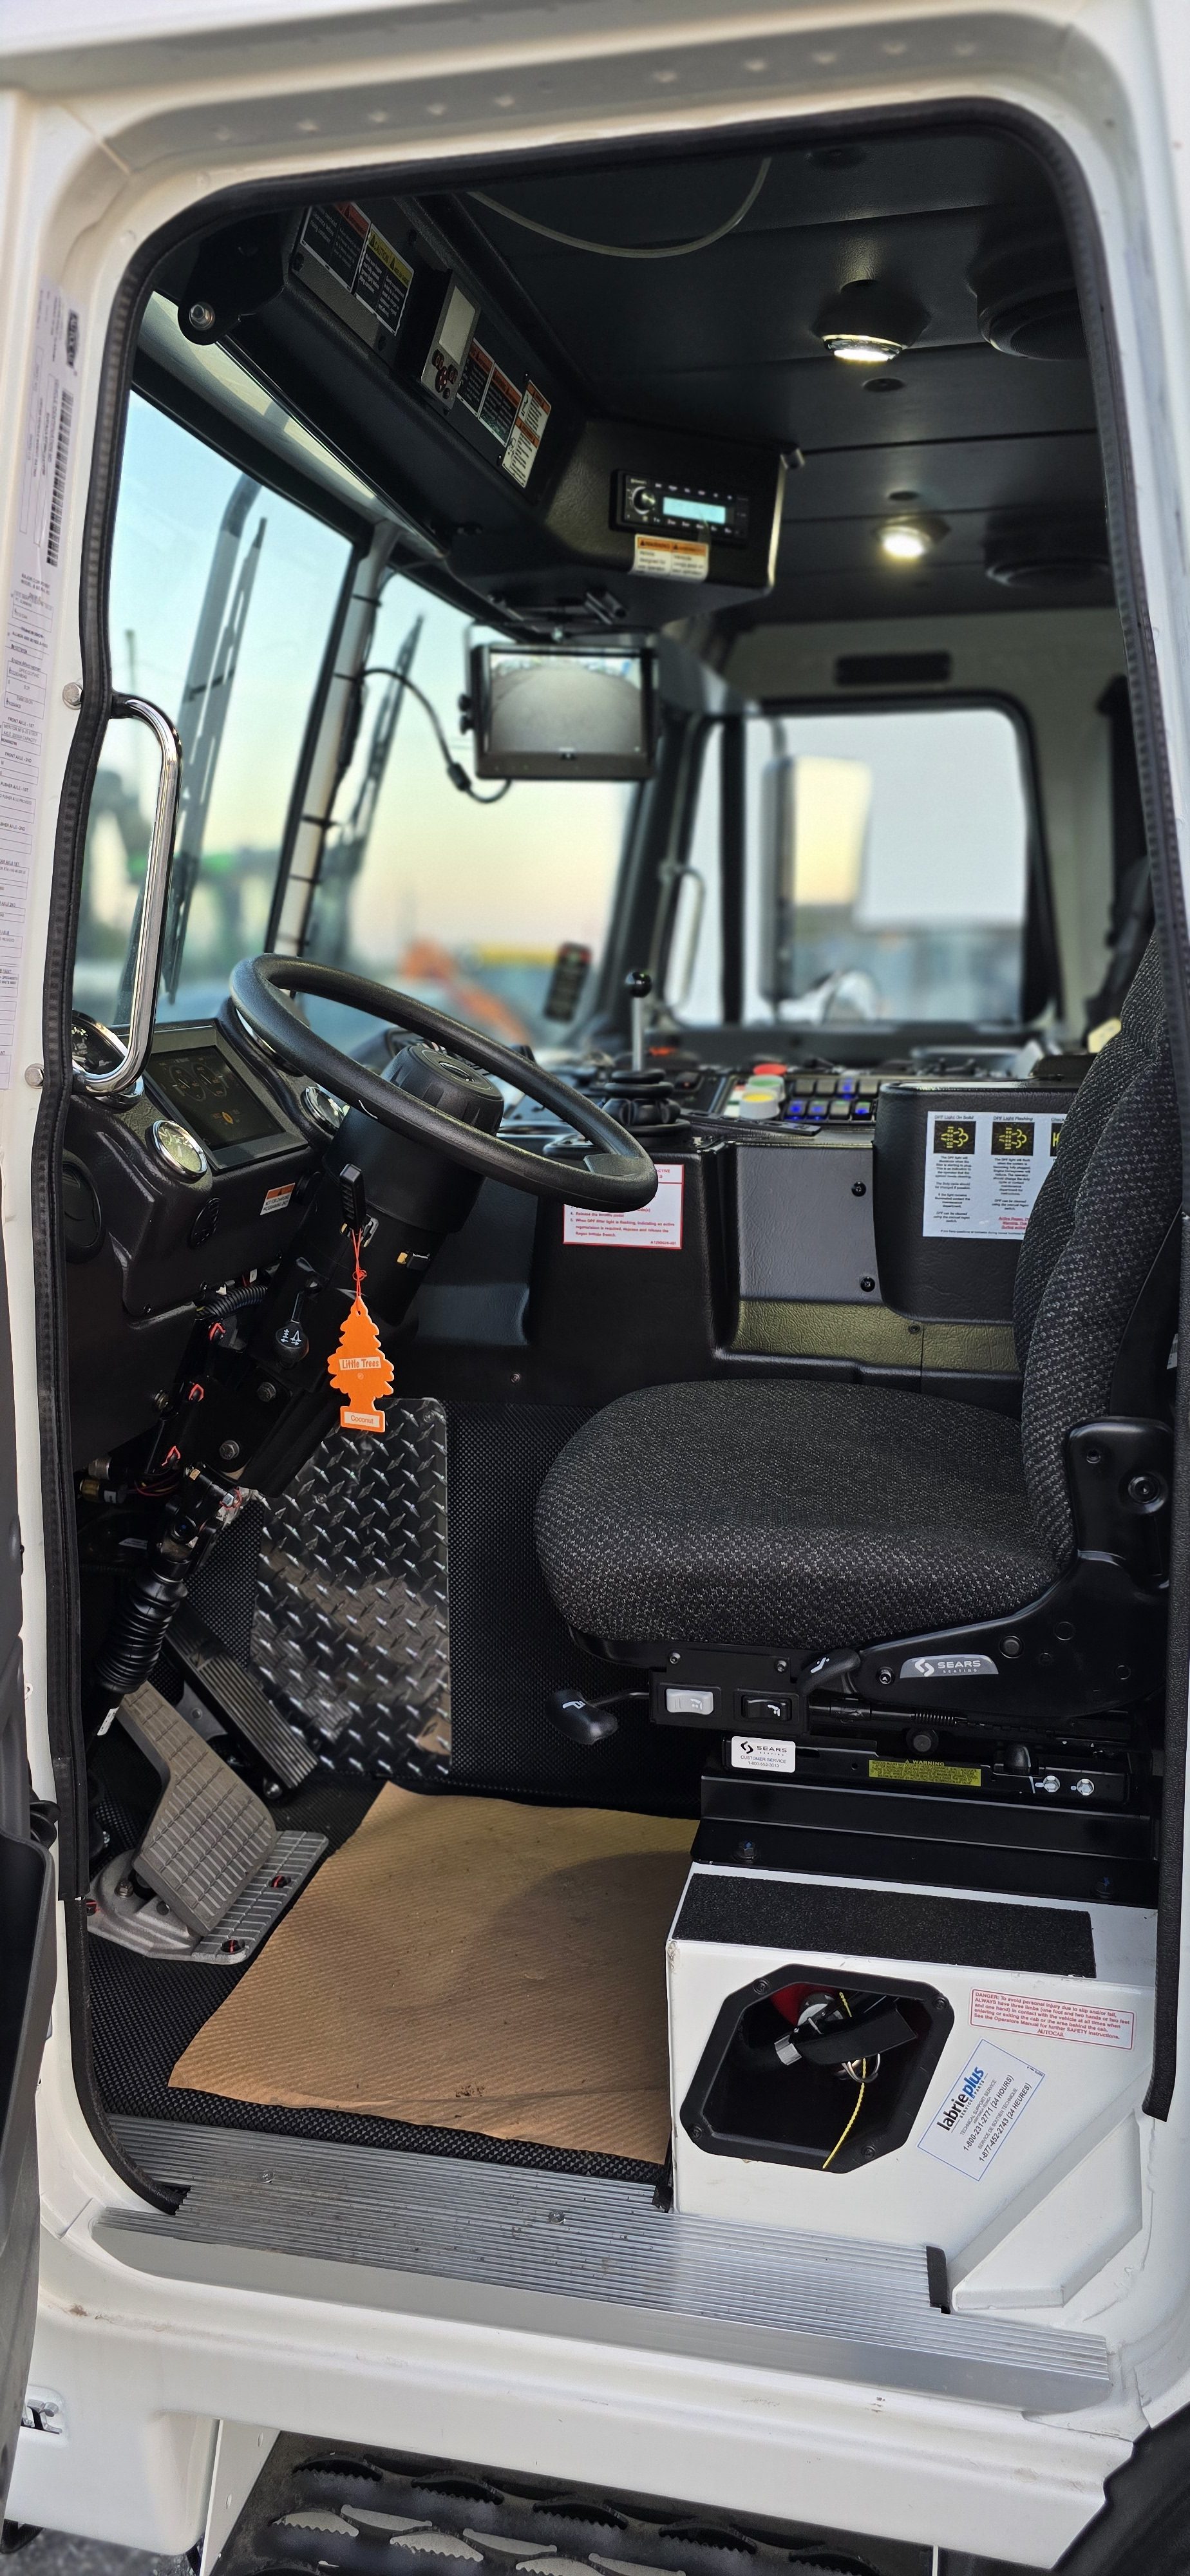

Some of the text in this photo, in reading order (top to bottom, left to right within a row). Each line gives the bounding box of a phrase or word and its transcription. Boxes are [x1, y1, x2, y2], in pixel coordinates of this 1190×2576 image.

[342, 1358, 379, 1369] Little Trees
[350, 1415, 373, 1425] Coconut
[938, 1660, 981, 1669] SEARS
[1037, 2029, 1064, 2037] AUTOCAR
[1088, 2031, 1119, 2039] instructions.
[959, 2080, 984, 2118] SERVICE PARTS
[959, 2079, 997, 2135] TECHNICAL SUPPORT SERVICE
[963, 2075, 1014, 2151] 1-800-231-2771 (24 HOURS)
[978, 2132, 990, 2149] SERVICE
[992, 2110, 1004, 2126] SOUTIEN
[1001, 2088, 1017, 2110] TECHNIQUE
[979, 2083, 1032, 2161] 1-877-452-2743 (24 HEURES)
